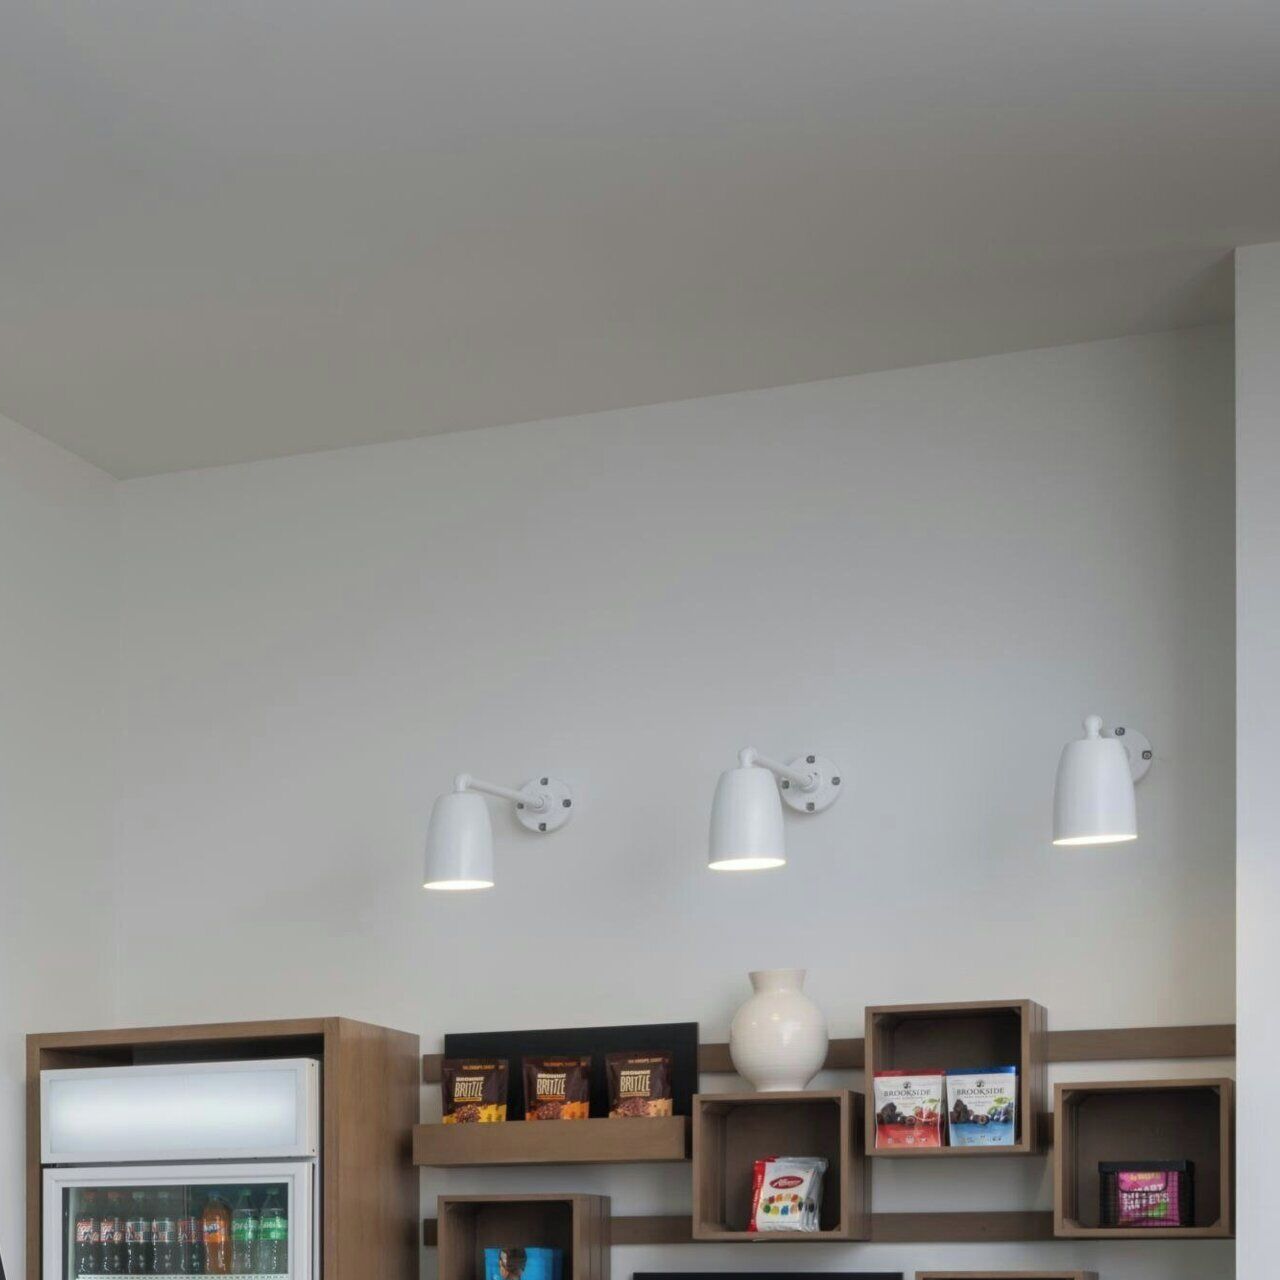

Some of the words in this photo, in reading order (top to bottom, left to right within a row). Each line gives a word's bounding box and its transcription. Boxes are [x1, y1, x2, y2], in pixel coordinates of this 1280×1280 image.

[455, 1081, 484, 1098] BRITTLE
[537, 1078, 565, 1095] BRITTLE
[620, 1075, 651, 1092] BRITTLE
[956, 1087, 1005, 1096] BROOKSIDE
[883, 1088, 931, 1097] BROOKSIDE
